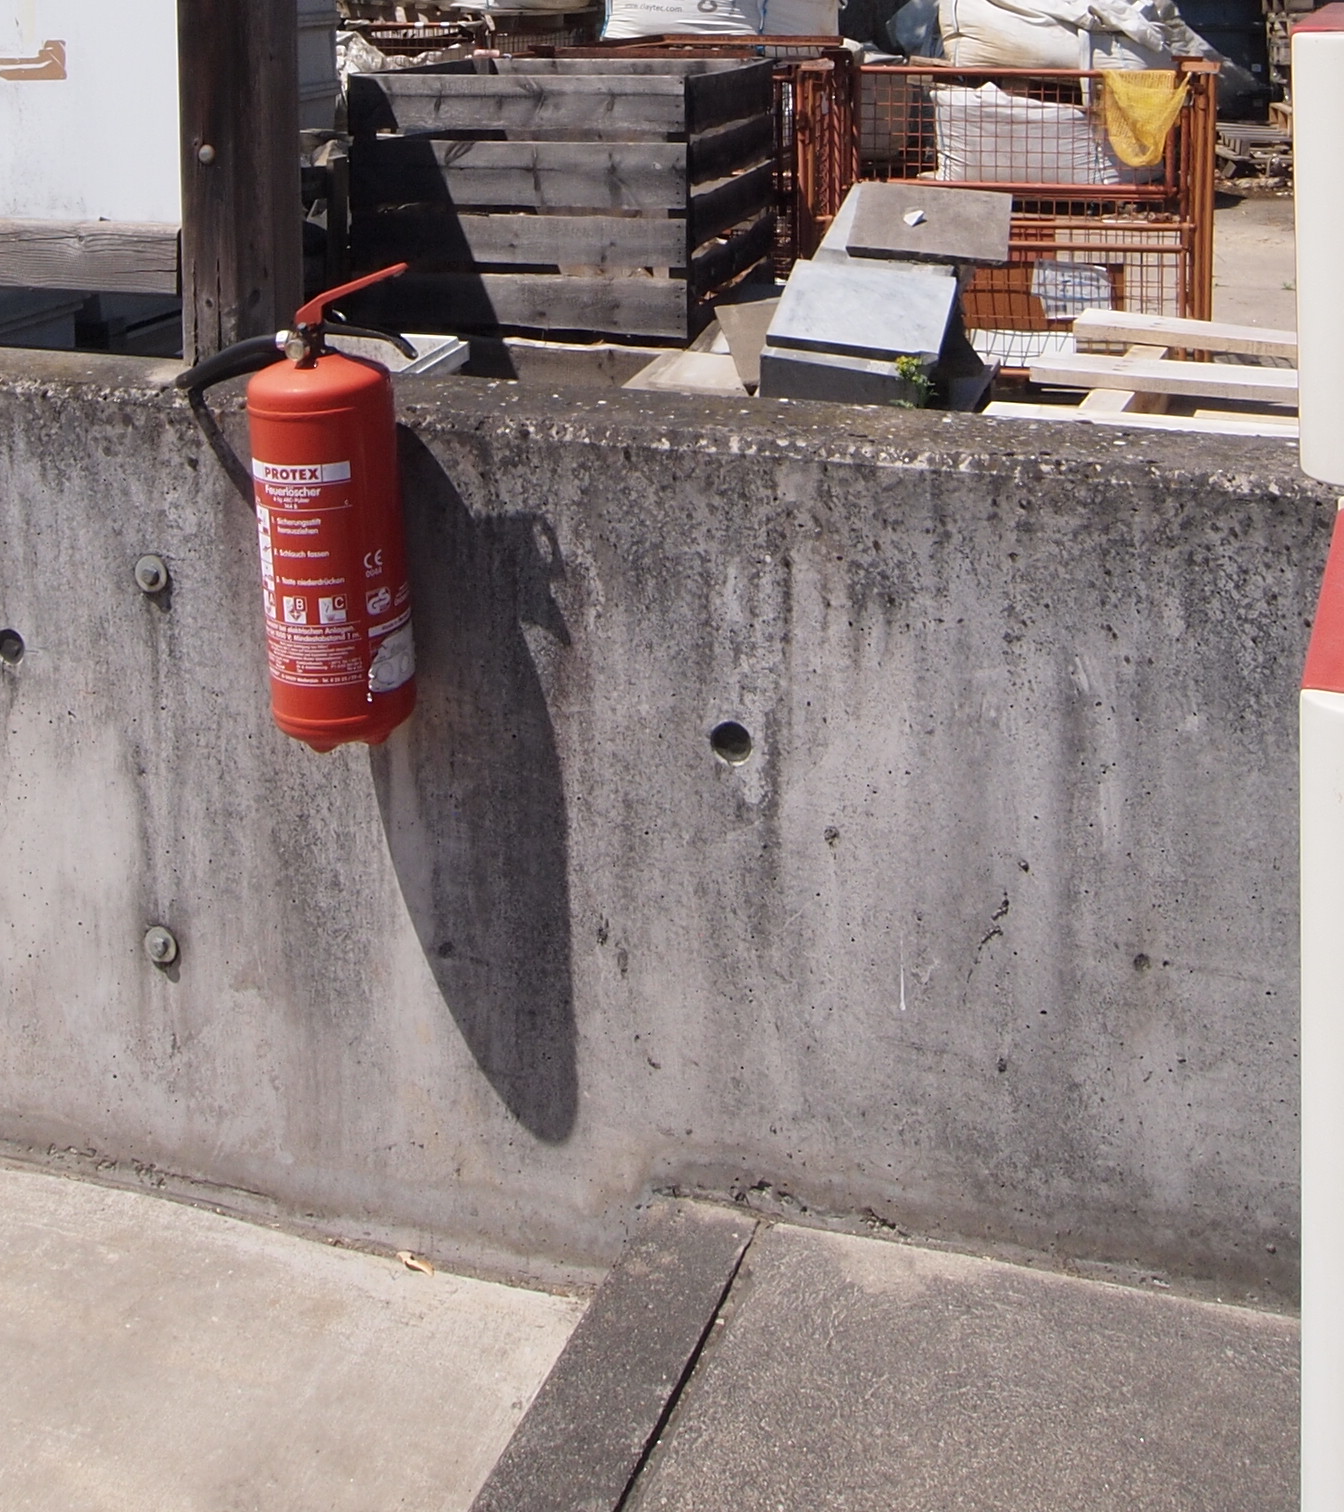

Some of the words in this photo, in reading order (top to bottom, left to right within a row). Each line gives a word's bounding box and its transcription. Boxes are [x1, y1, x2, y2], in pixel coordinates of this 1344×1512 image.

[264, 466, 320, 481] PROTEX
[264, 483, 321, 497] Feuerlöscher
[296, 598, 304, 610] B
[334, 596, 345, 609] C
